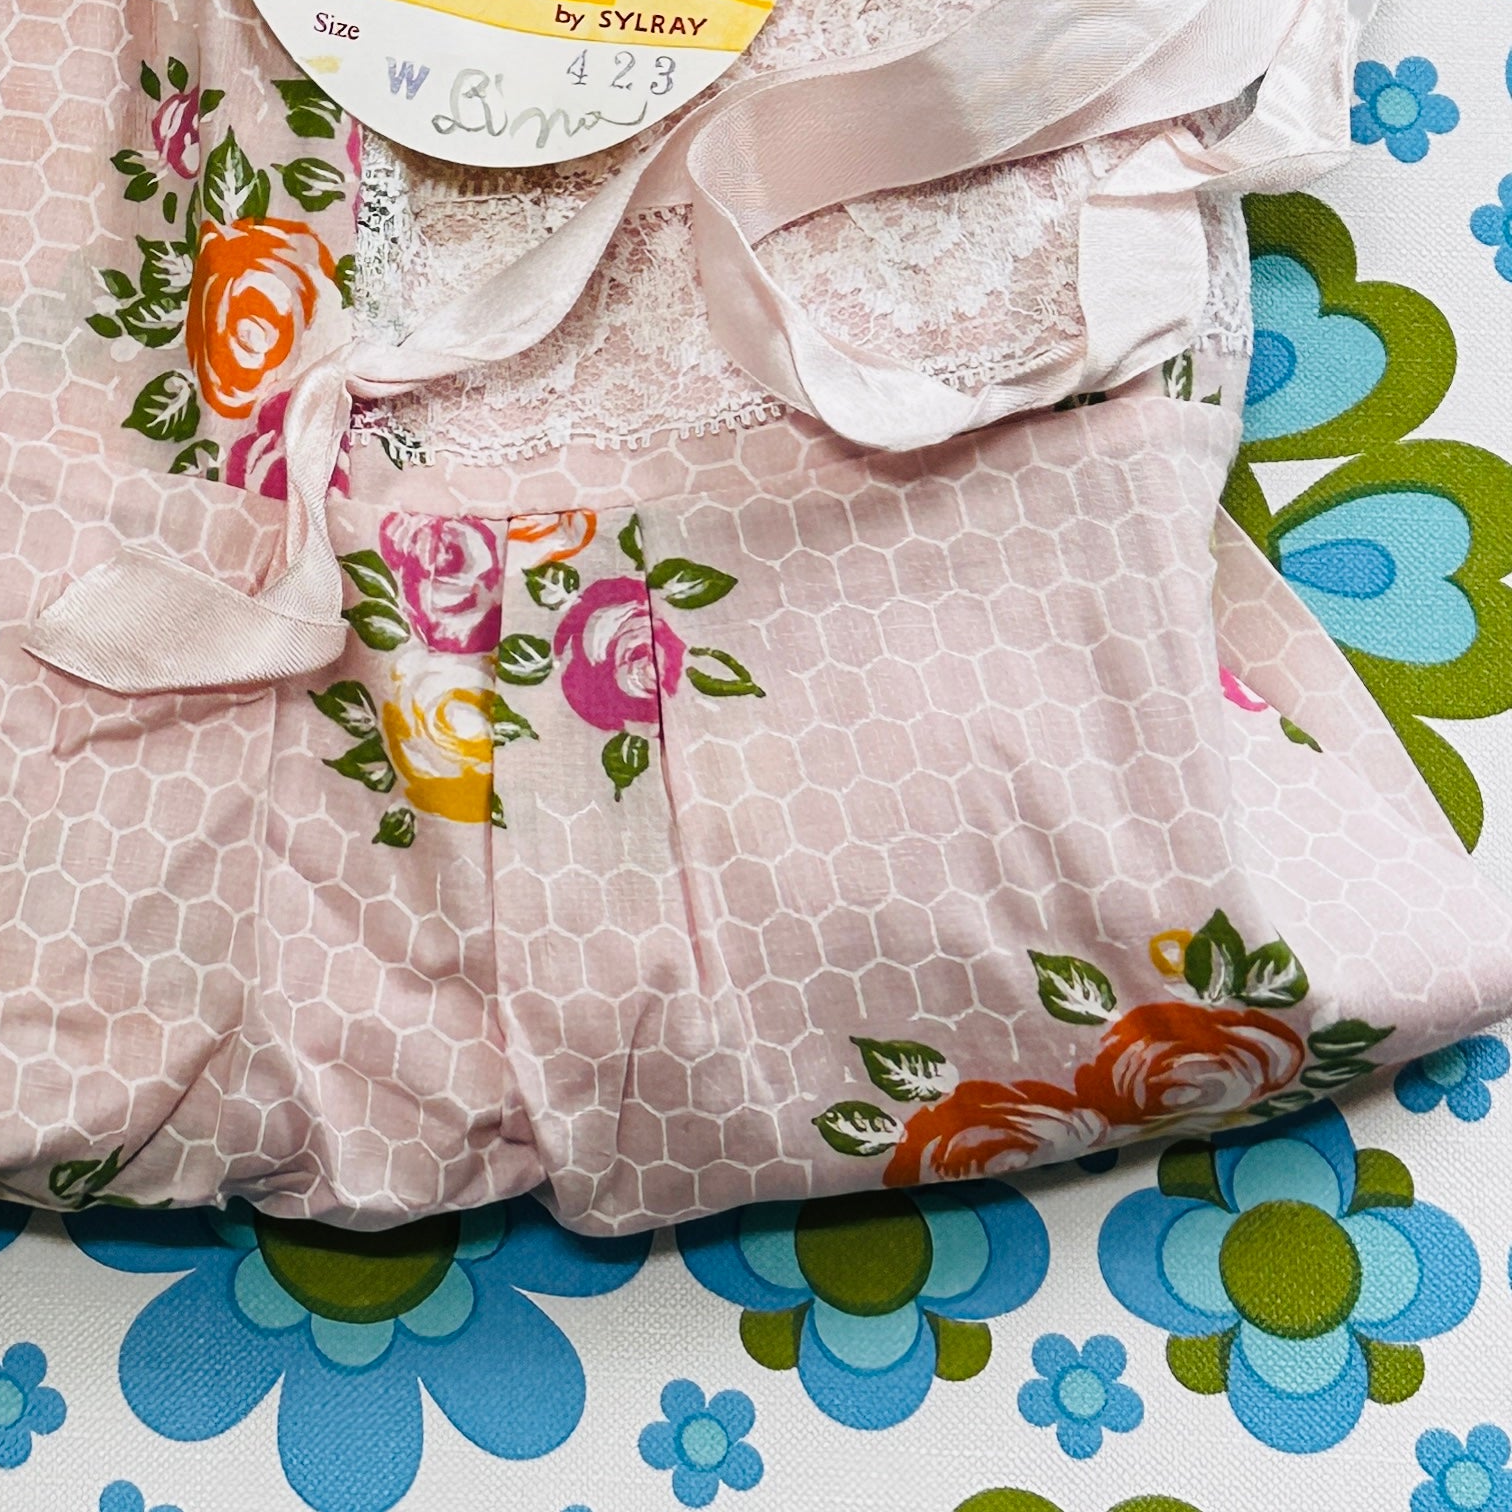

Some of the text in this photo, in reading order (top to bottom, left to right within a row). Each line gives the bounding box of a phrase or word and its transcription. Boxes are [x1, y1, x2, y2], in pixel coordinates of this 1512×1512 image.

[313, 11, 361, 41] Size
[554, 4, 708, 37] by SYLRAY
[386, 56, 431, 100] W
